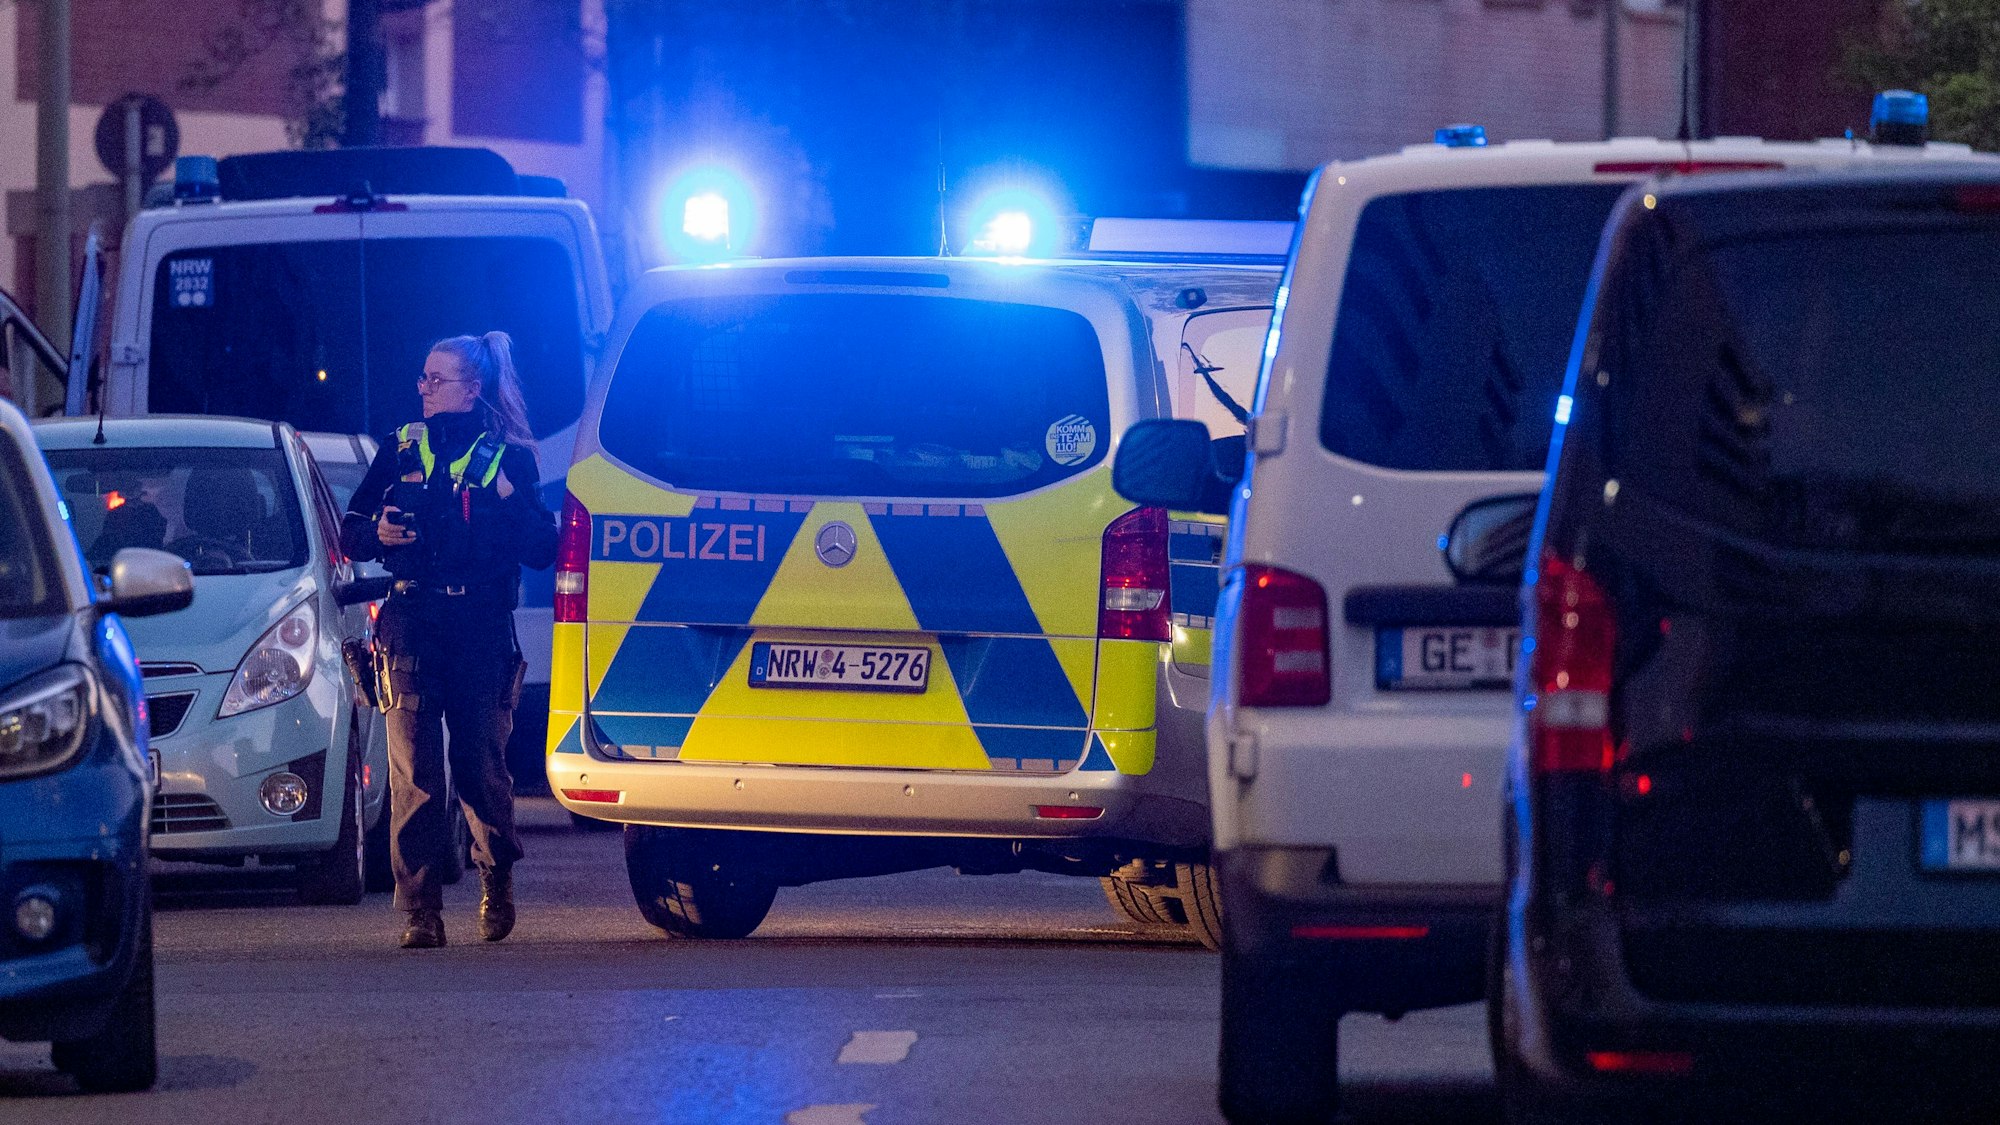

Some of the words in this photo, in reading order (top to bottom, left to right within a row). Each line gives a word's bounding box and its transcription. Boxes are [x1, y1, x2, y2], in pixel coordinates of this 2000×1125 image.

[170, 259, 212, 275] NRW
[1056, 424, 1086, 434] KOMM
[1059, 433, 1090, 442] TEAM
[1056, 442, 1077, 453] 110!
[602, 520, 766, 561] POLIZEI
[1421, 632, 1473, 672] GE
[756, 666, 764, 676] D
[767, 649, 818, 678] NRW
[831, 651, 924, 681] 4-5276
